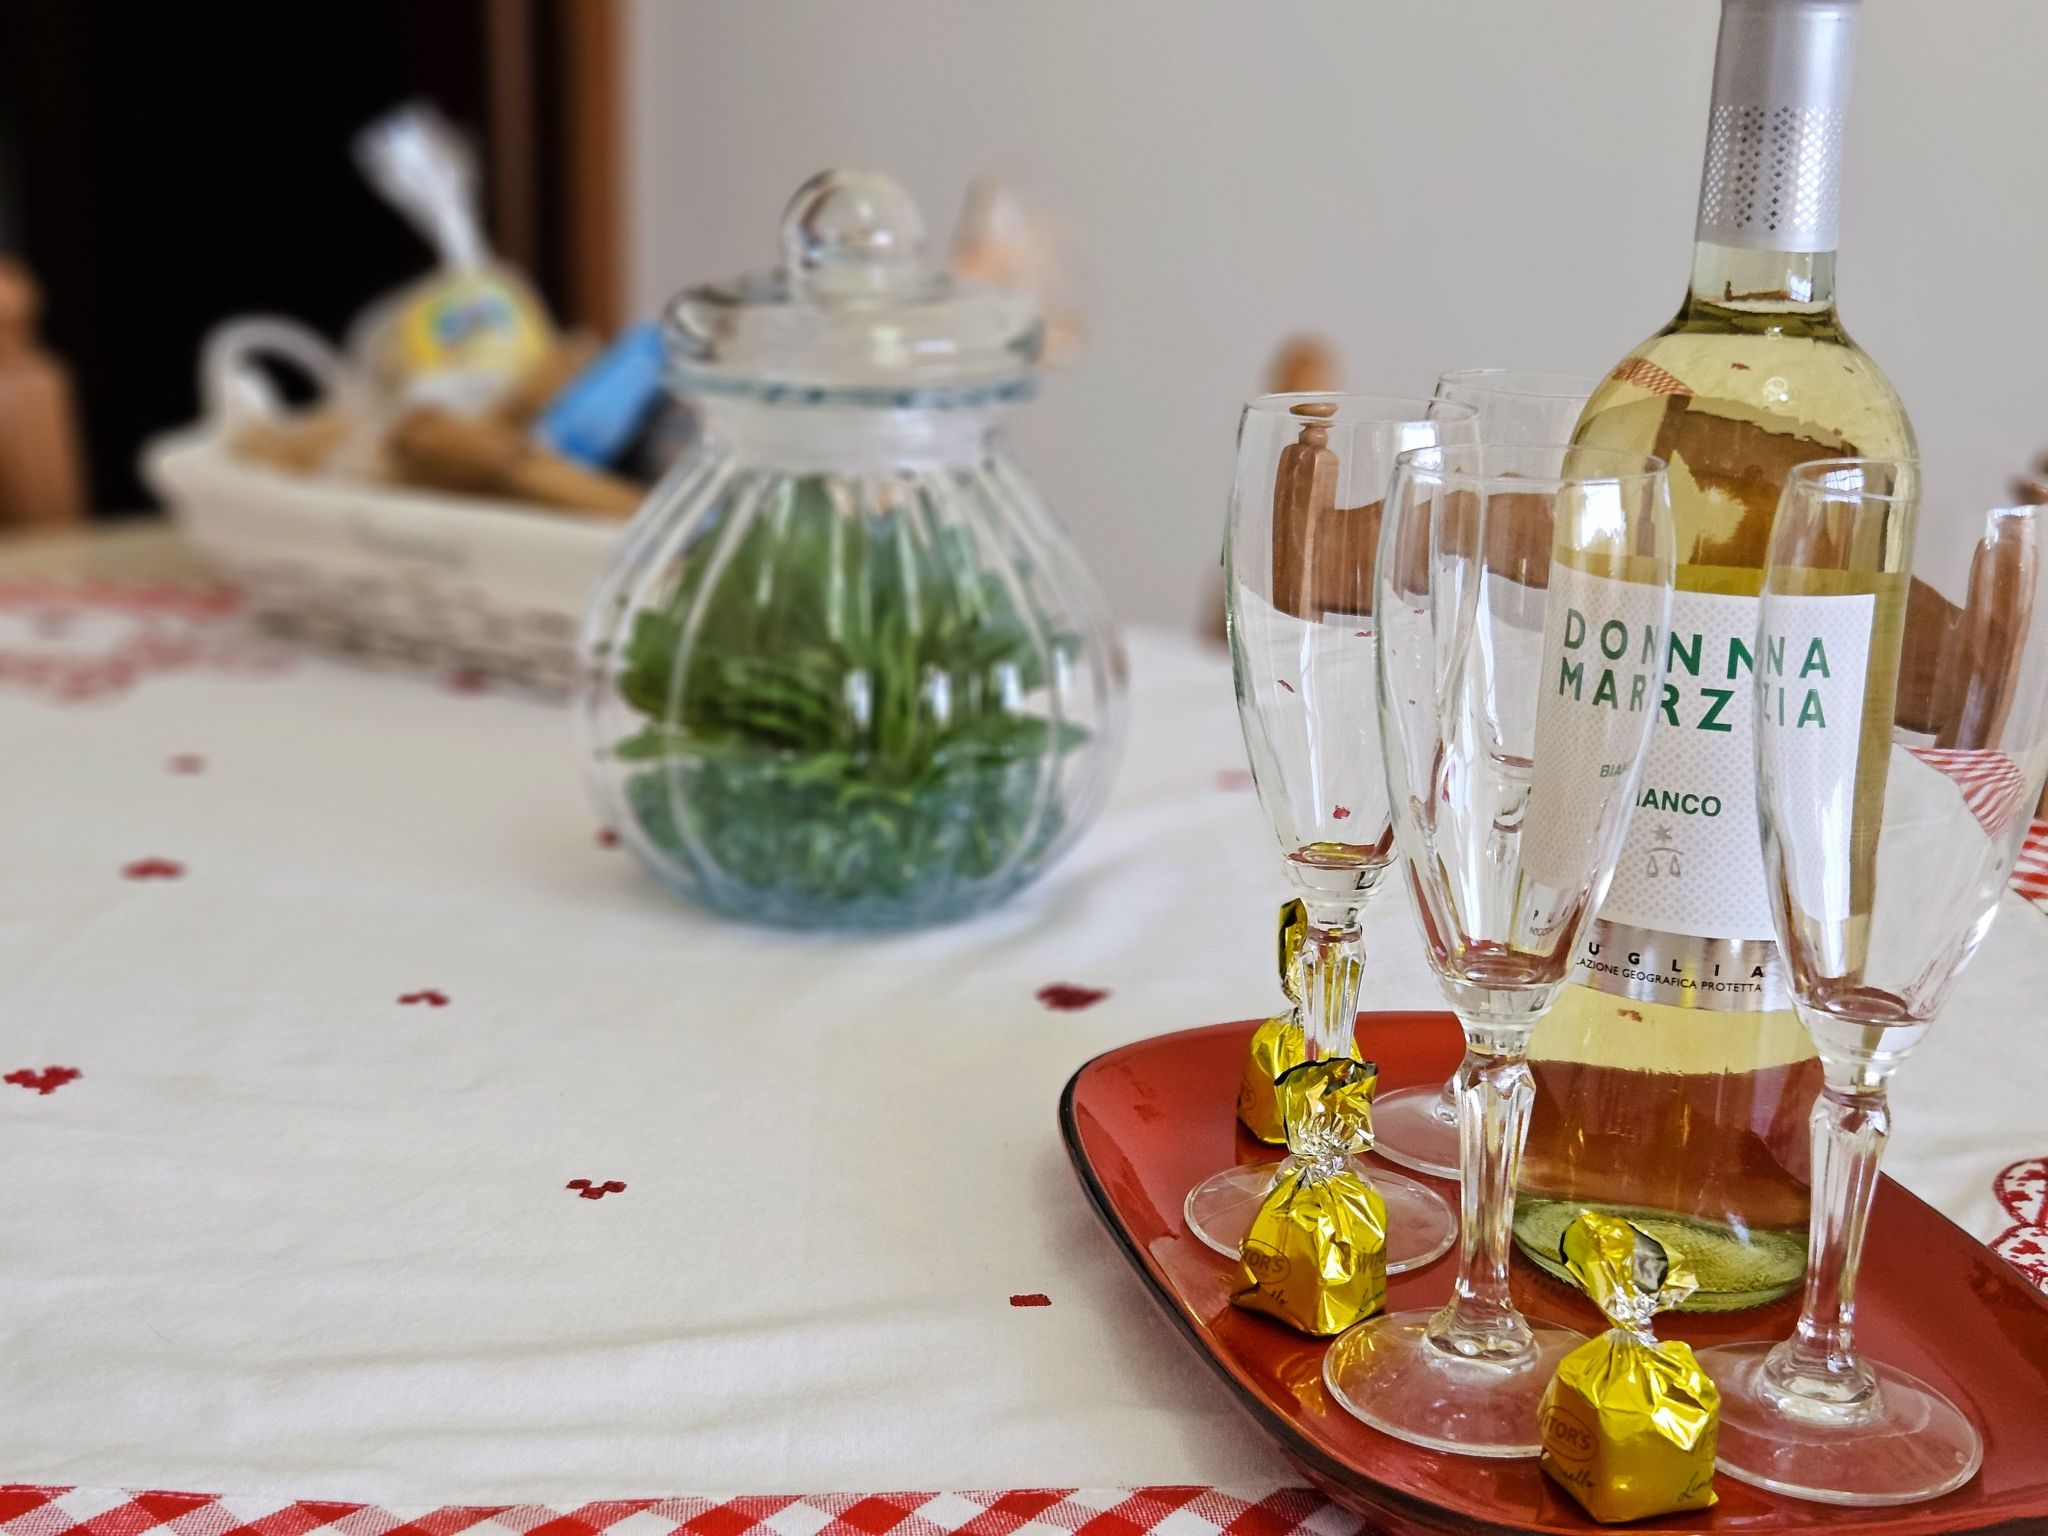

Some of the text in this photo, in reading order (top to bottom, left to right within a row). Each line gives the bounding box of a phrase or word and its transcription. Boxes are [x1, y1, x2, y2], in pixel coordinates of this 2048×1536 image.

[1588, 941, 1765, 978] UGLIA
[1621, 967, 1698, 990] GEOGRAFICA
[1700, 981, 1762, 993] PROTETTA
